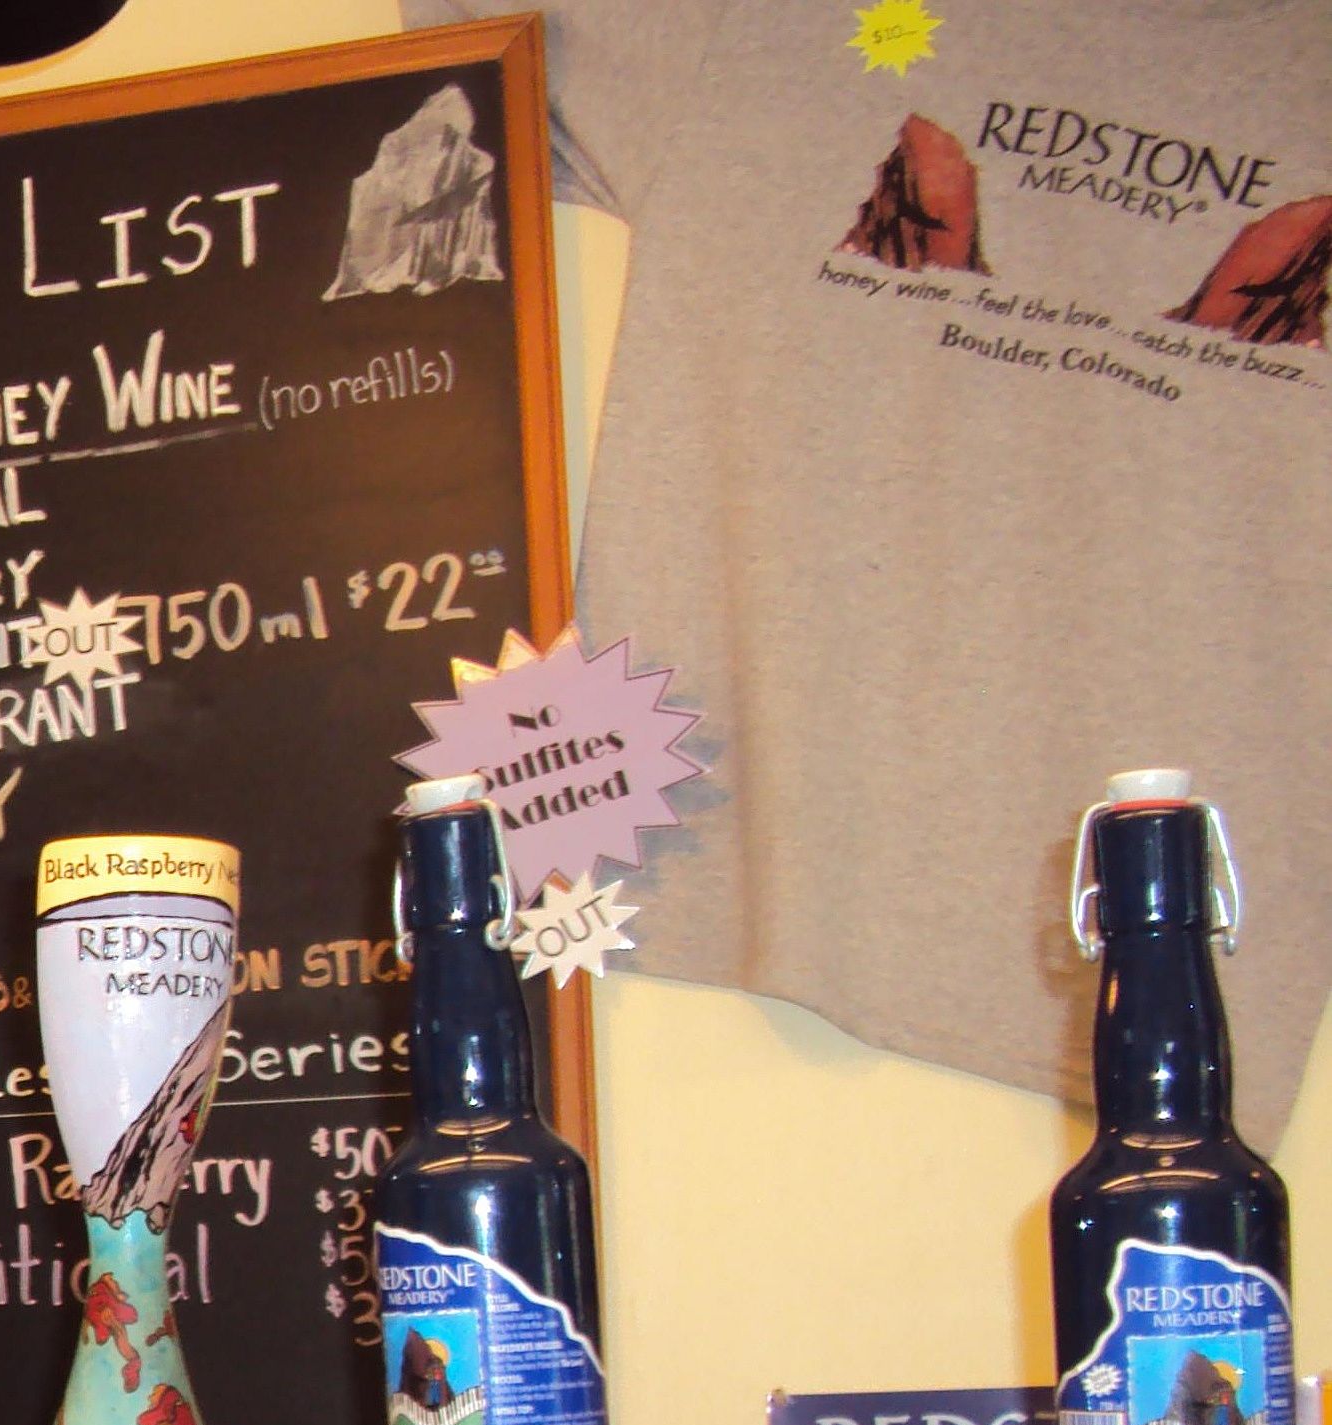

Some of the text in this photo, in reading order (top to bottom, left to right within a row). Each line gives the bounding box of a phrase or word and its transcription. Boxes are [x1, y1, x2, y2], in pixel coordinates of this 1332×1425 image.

[977, 102, 1277, 209] REDSTONE
[1018, 164, 1196, 225] MEADERY
[22, 176, 281, 298] LIST
[817, 260, 888, 297] honey
[1021, 298, 1059, 325] the
[1200, 340, 1239, 369] the
[92, 328, 242, 432] WINE
[258, 375, 320, 430] (no
[329, 347, 454, 409] refills)
[939, 322, 1182, 402] Boulder, Colorado
[43, 621, 118, 658] OUT
[44, 852, 215, 885] Black Raspberry
[535, 895, 613, 957] OUT
[105, 972, 224, 999] MEADERY
[217, 1027, 410, 1083] Series
[1125, 1281, 1266, 1313] REDSTONE
[1153, 1309, 1241, 1328] MEADERY
